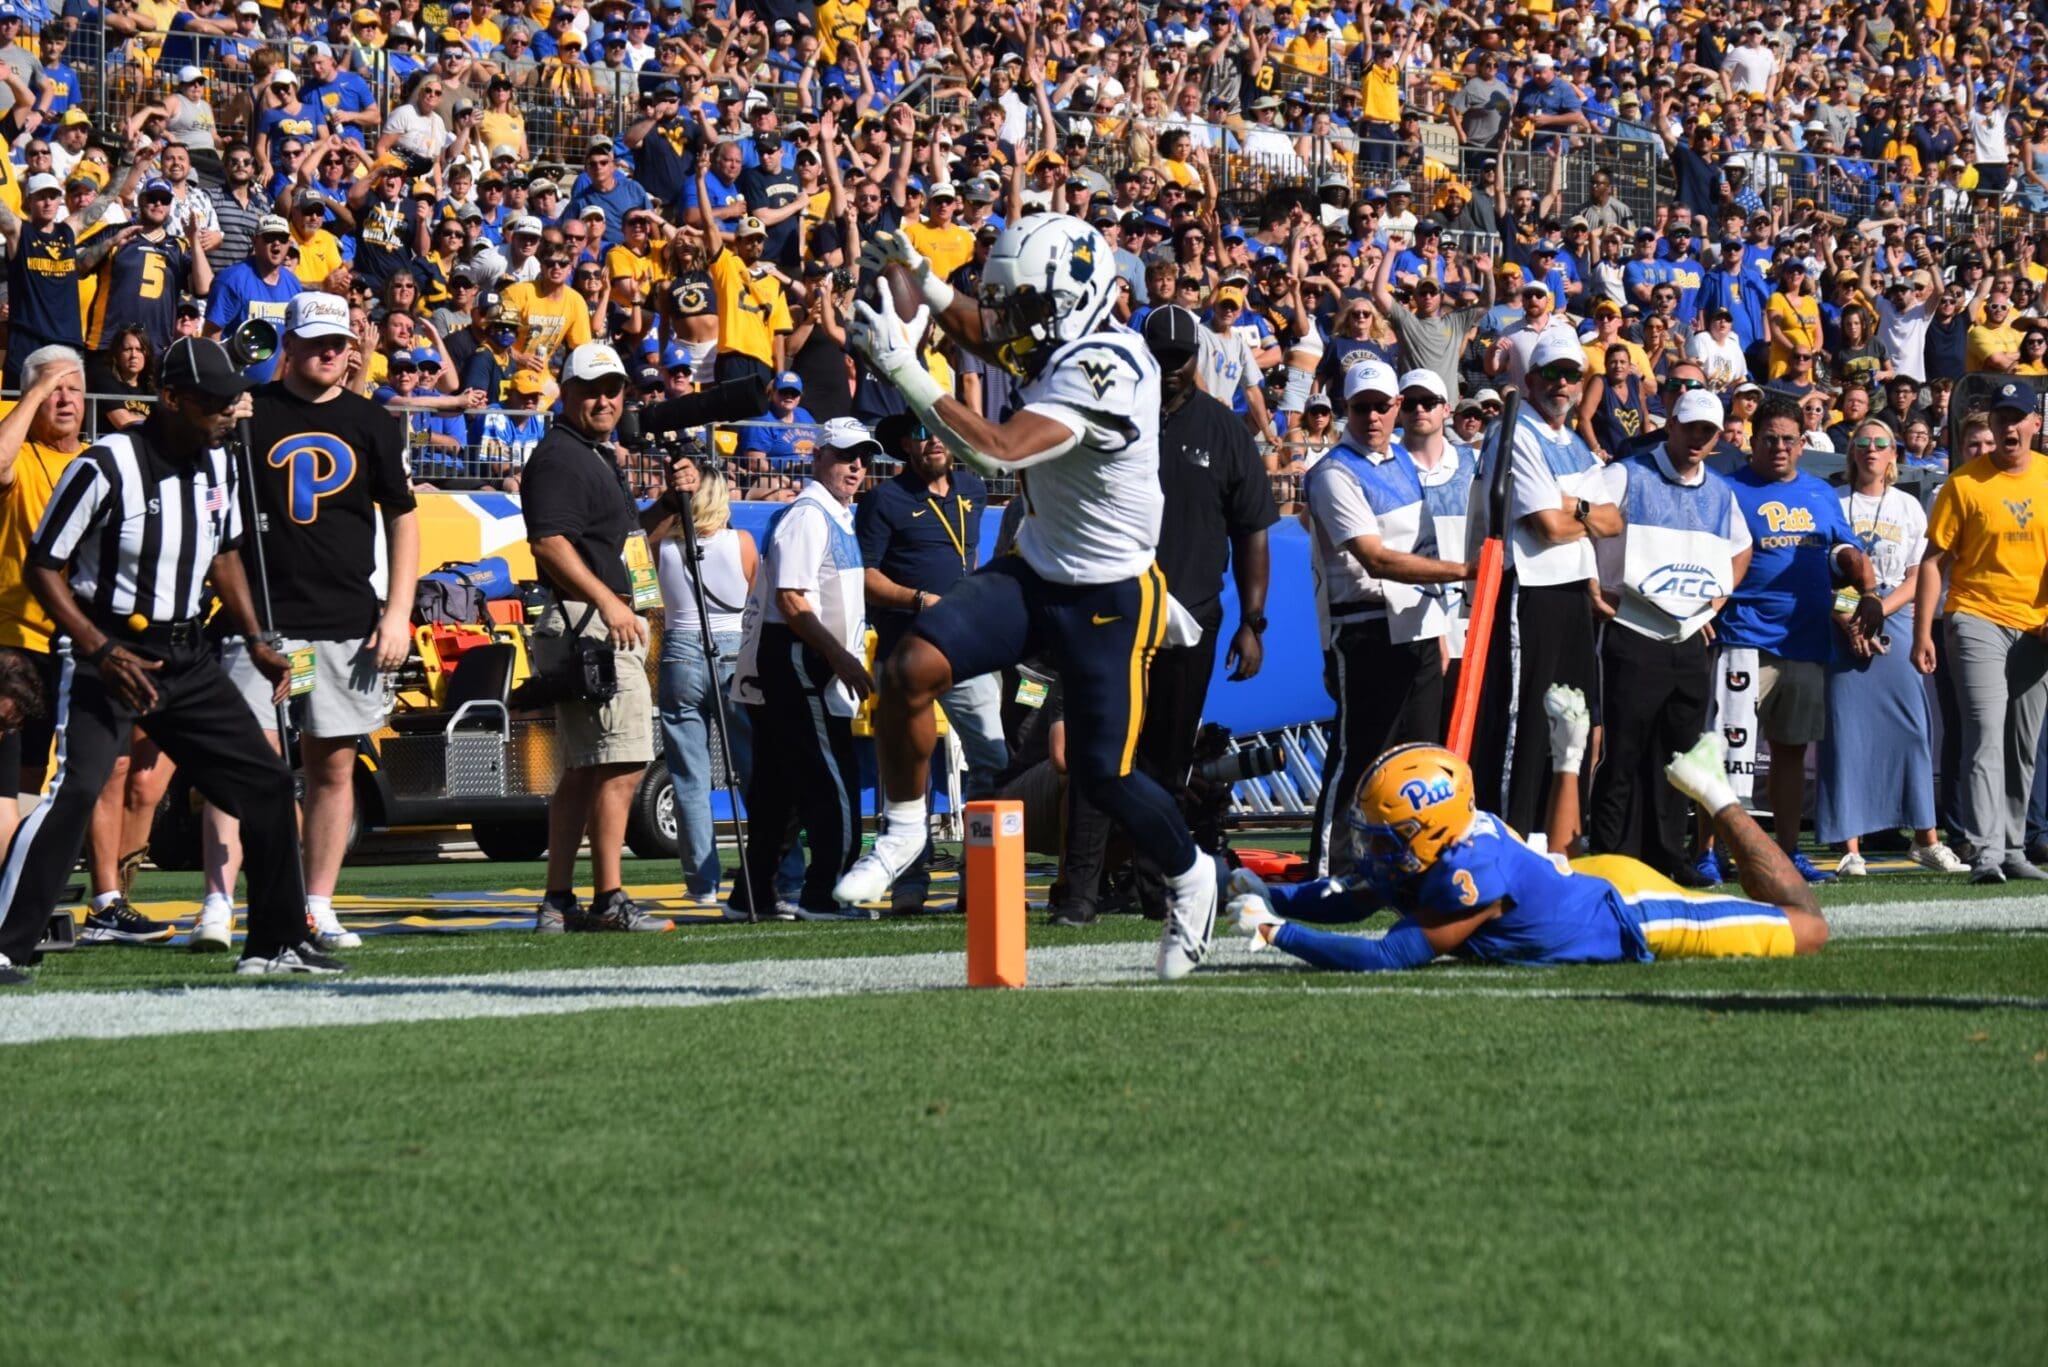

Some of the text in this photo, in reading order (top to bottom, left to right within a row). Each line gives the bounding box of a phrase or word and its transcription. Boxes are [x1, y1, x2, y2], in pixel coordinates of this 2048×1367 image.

[138, 252, 166, 299] 5
[269, 431, 357, 525] P
[148, 498, 160, 515] S
[1757, 501, 1816, 532] Pitt
[1761, 536, 1822, 550] FOOTBALL
[1655, 577, 1719, 600] ACC
[1398, 778, 1455, 811] Pitt
[1450, 868, 1479, 907] 3
